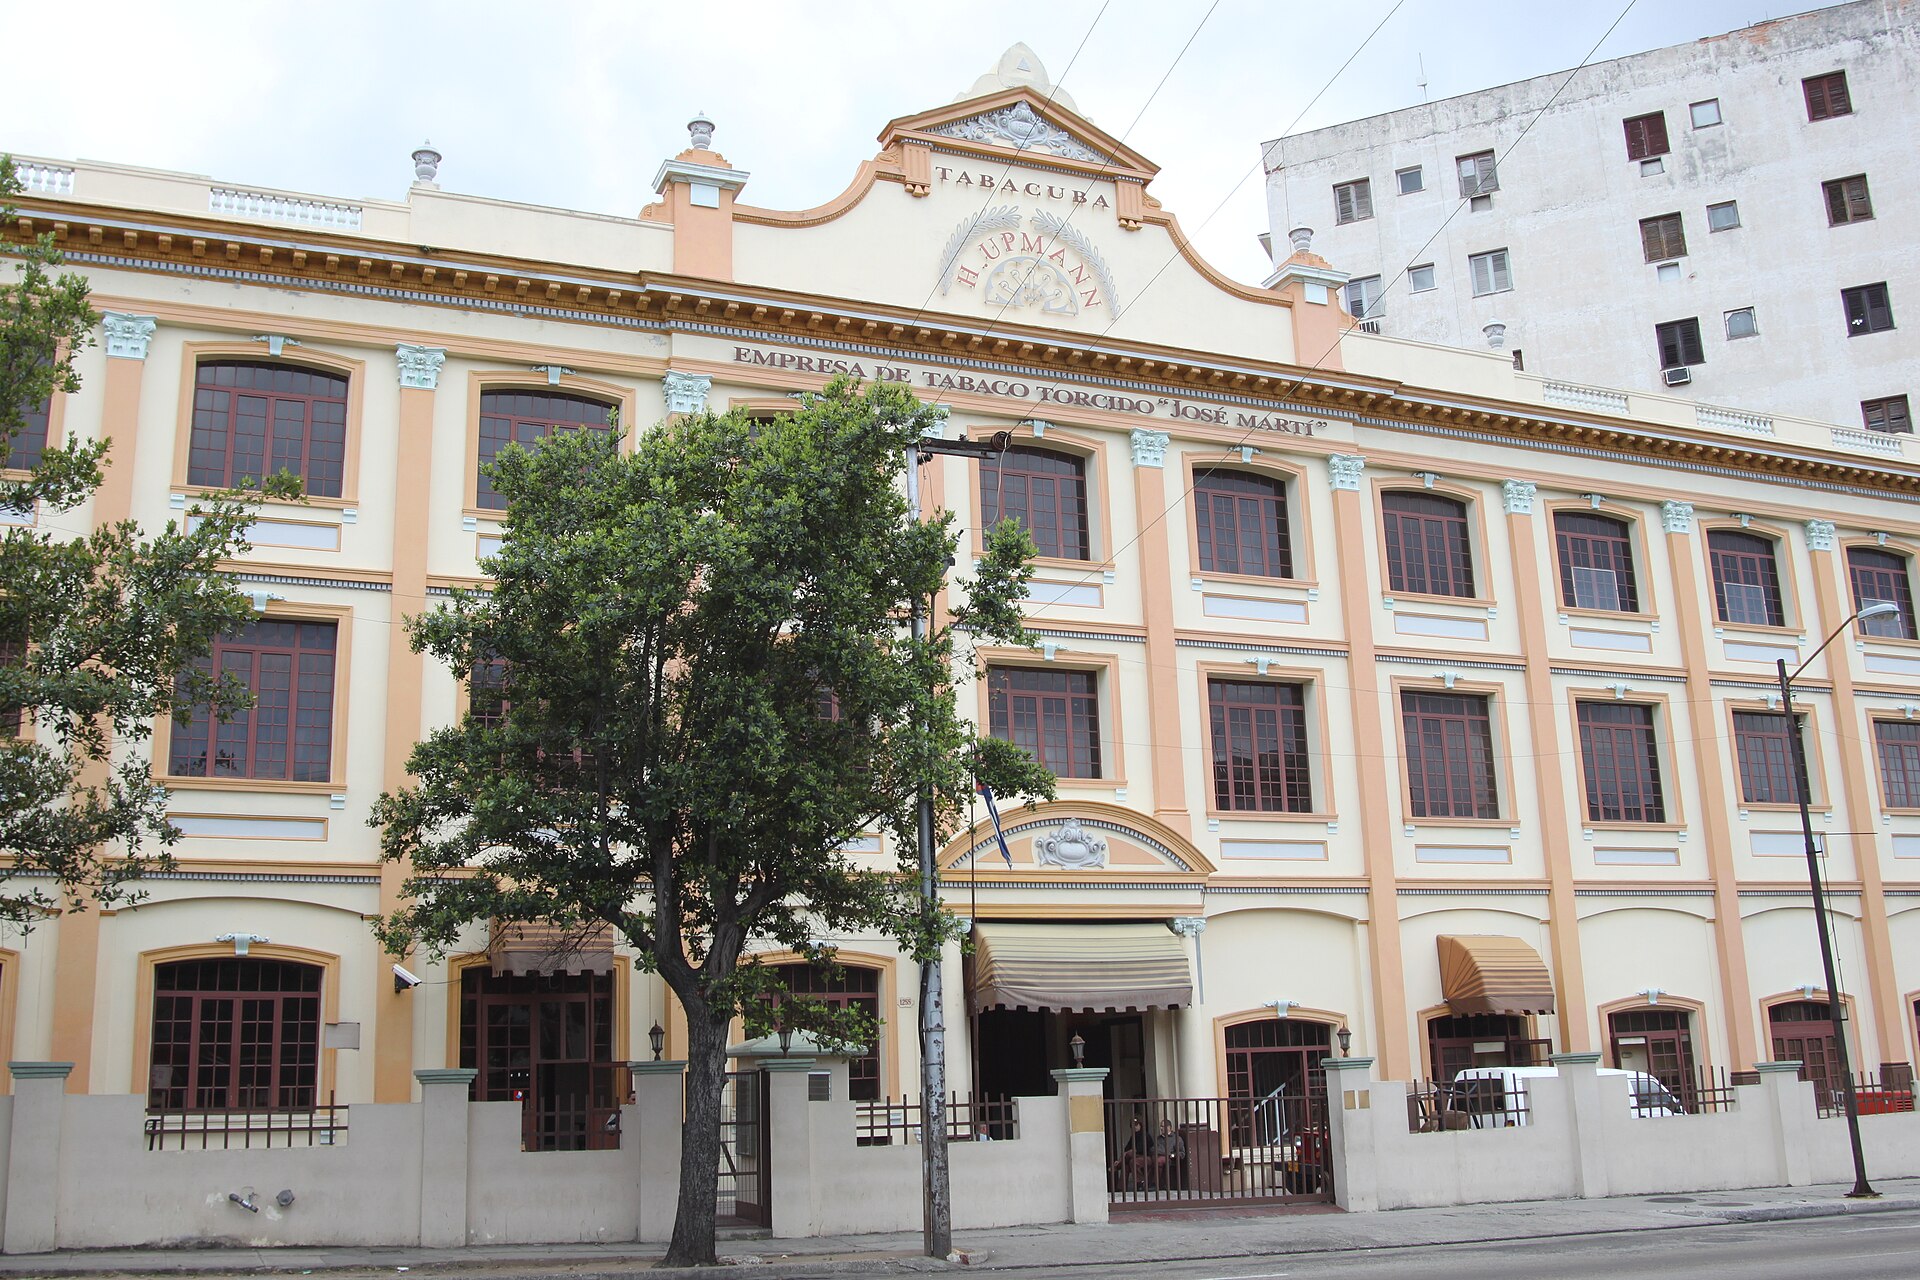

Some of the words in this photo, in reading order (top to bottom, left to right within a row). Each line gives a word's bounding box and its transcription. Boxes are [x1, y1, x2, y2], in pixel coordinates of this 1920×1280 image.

[935, 166, 1110, 208] TABACUBA
[733, 346, 866, 378] EMPRESA
[874, 365, 912, 383] DE
[922, 371, 1030, 397] TABACO
[1036, 385, 1155, 414] TORCIDO
